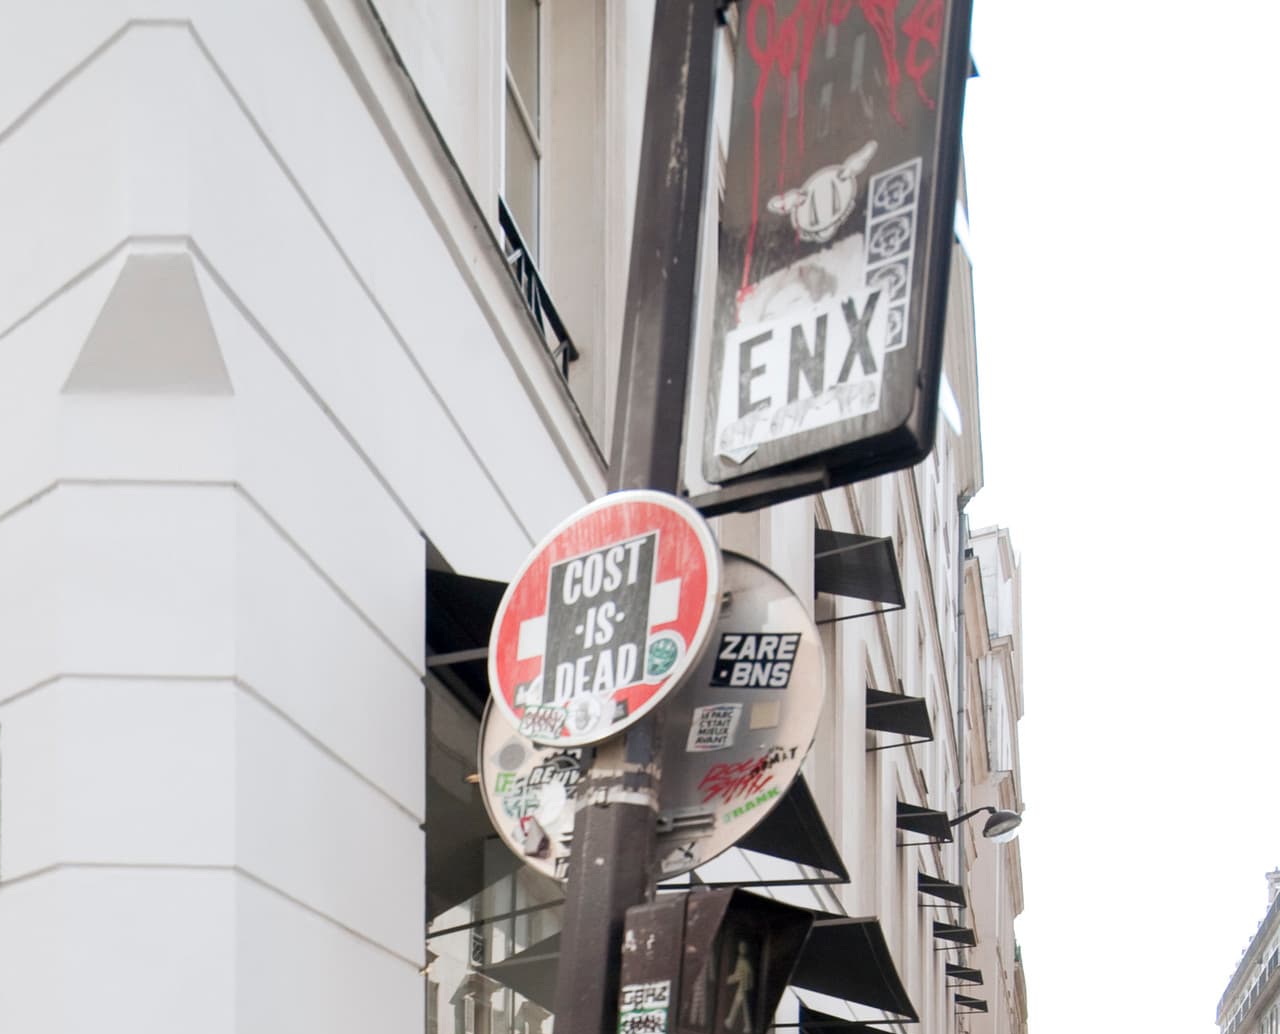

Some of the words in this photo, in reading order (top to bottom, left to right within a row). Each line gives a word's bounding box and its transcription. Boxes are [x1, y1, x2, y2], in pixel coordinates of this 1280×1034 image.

[562, 537, 648, 606] COST
[554, 642, 638, 703] DEAD
[720, 634, 800, 662] ZARE
